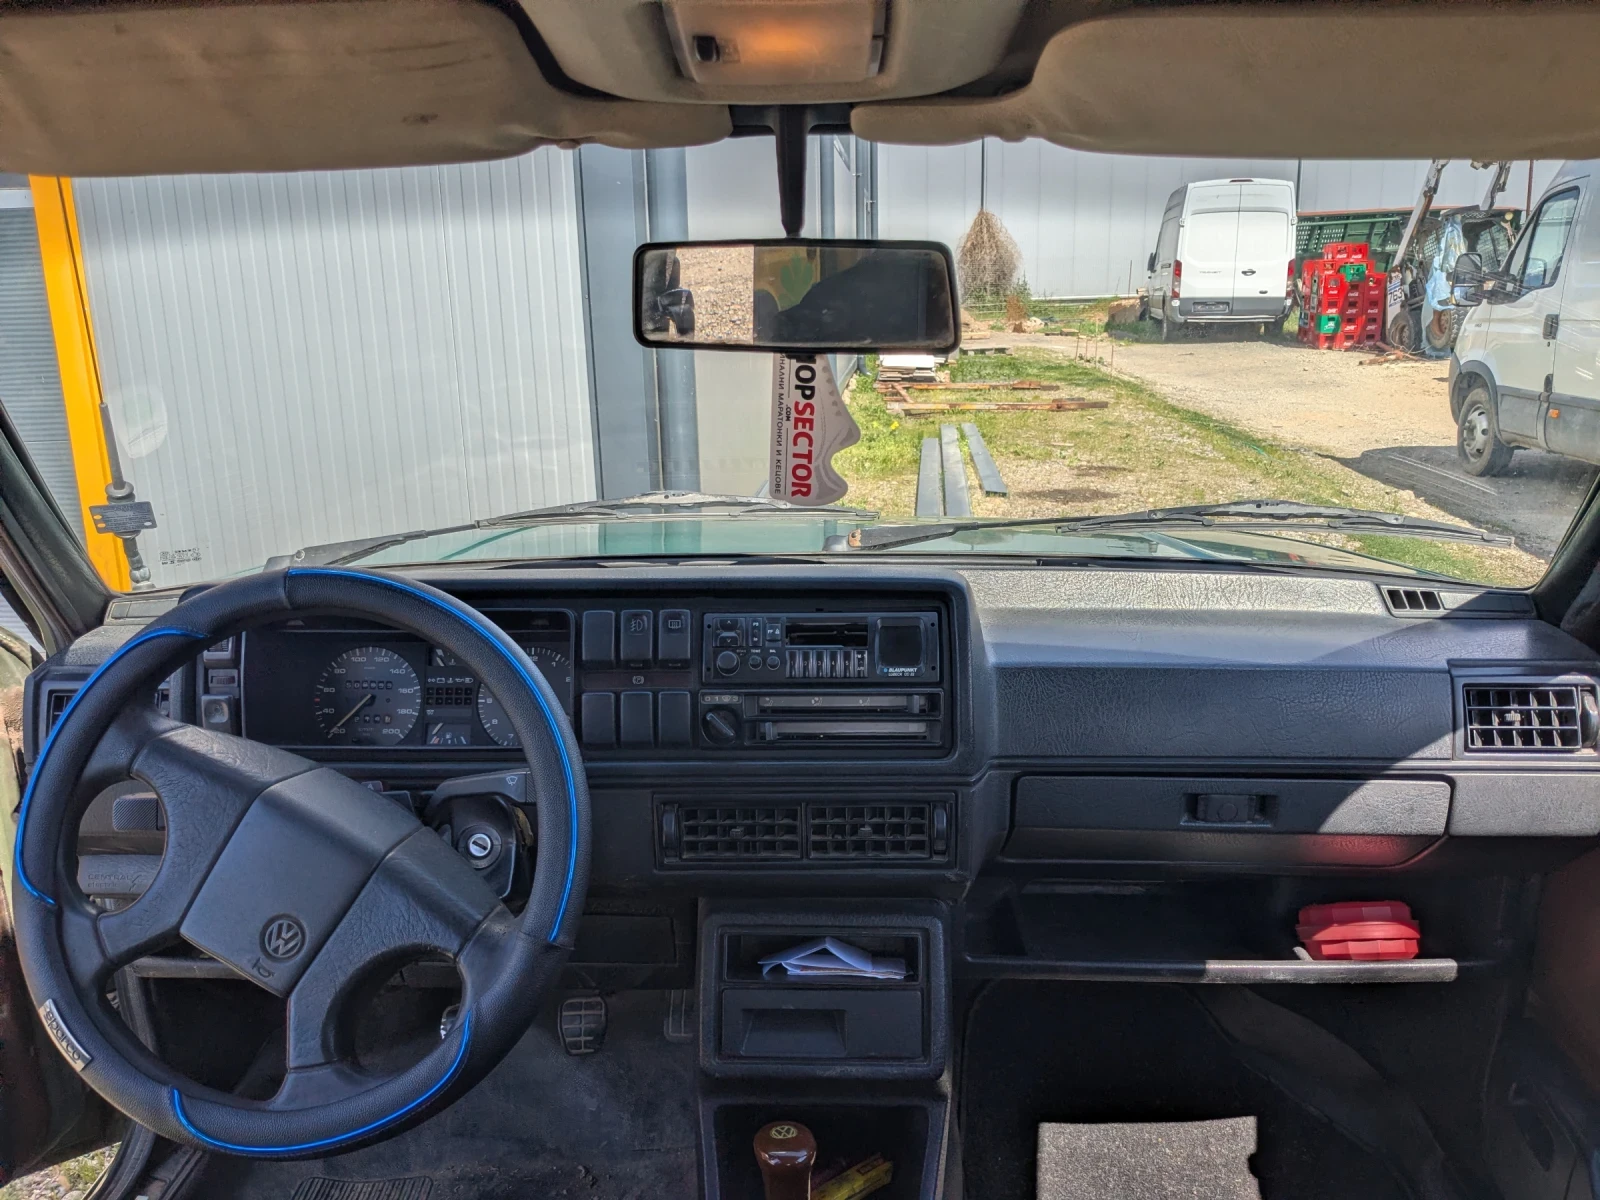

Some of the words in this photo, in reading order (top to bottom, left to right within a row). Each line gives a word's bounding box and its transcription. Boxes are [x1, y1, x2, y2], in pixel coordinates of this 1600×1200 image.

[1388, 287, 1405, 304] 763
[776, 392, 785, 447] МАРАТОНКИ
[791, 355, 816, 497] OPSECTOR
[774, 459, 782, 494] КЕЦОВЕ
